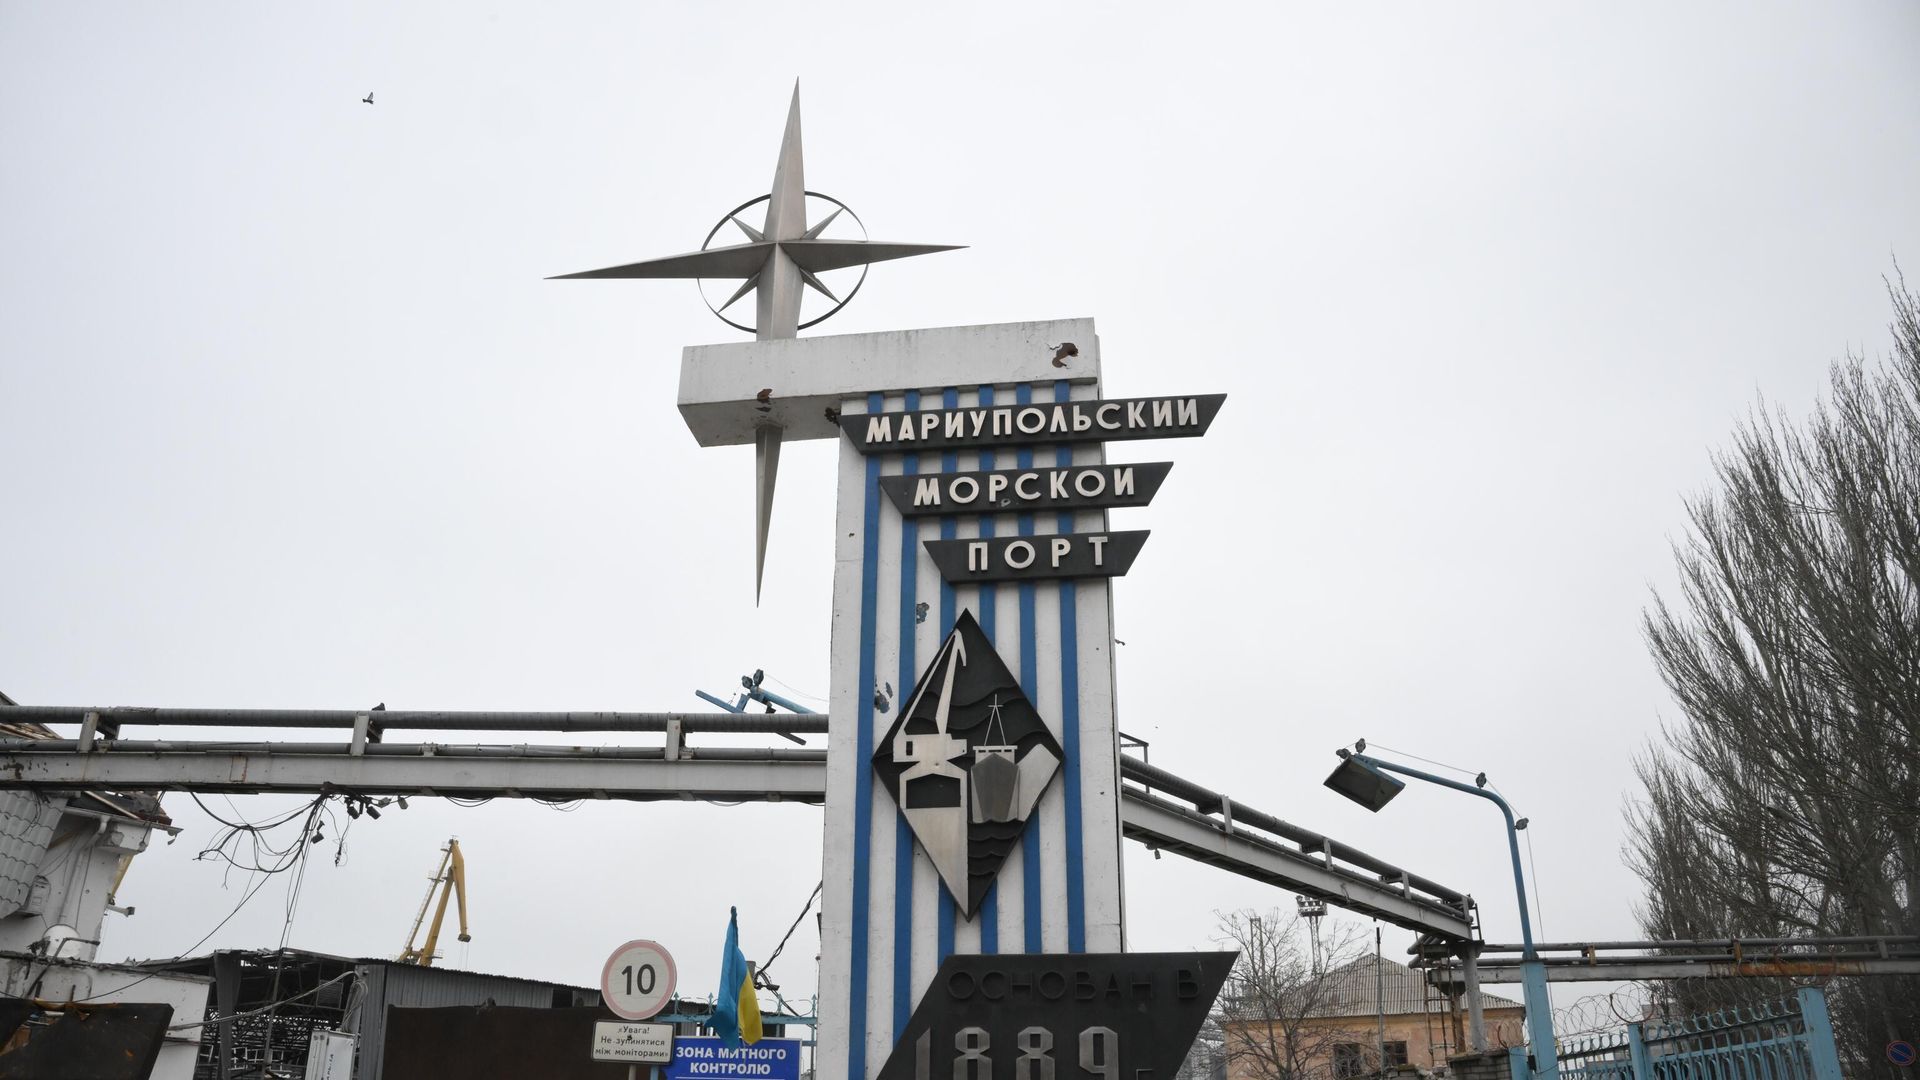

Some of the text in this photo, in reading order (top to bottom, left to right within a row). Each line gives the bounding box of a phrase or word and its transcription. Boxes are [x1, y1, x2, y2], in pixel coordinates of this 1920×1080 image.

[968, 536, 1108, 571] ПОРТ
[621, 963, 656, 996] 10
[947, 968, 1200, 1000] ОСНОВАН В
[600, 1035, 612, 1044] Не
[595, 1047, 611, 1055] між
[676, 1047, 787, 1060] ЗОНА МИТНОГО
[915, 1026, 1119, 1080] 1889
[690, 1062, 771, 1075] КОНТРОЛЮ
